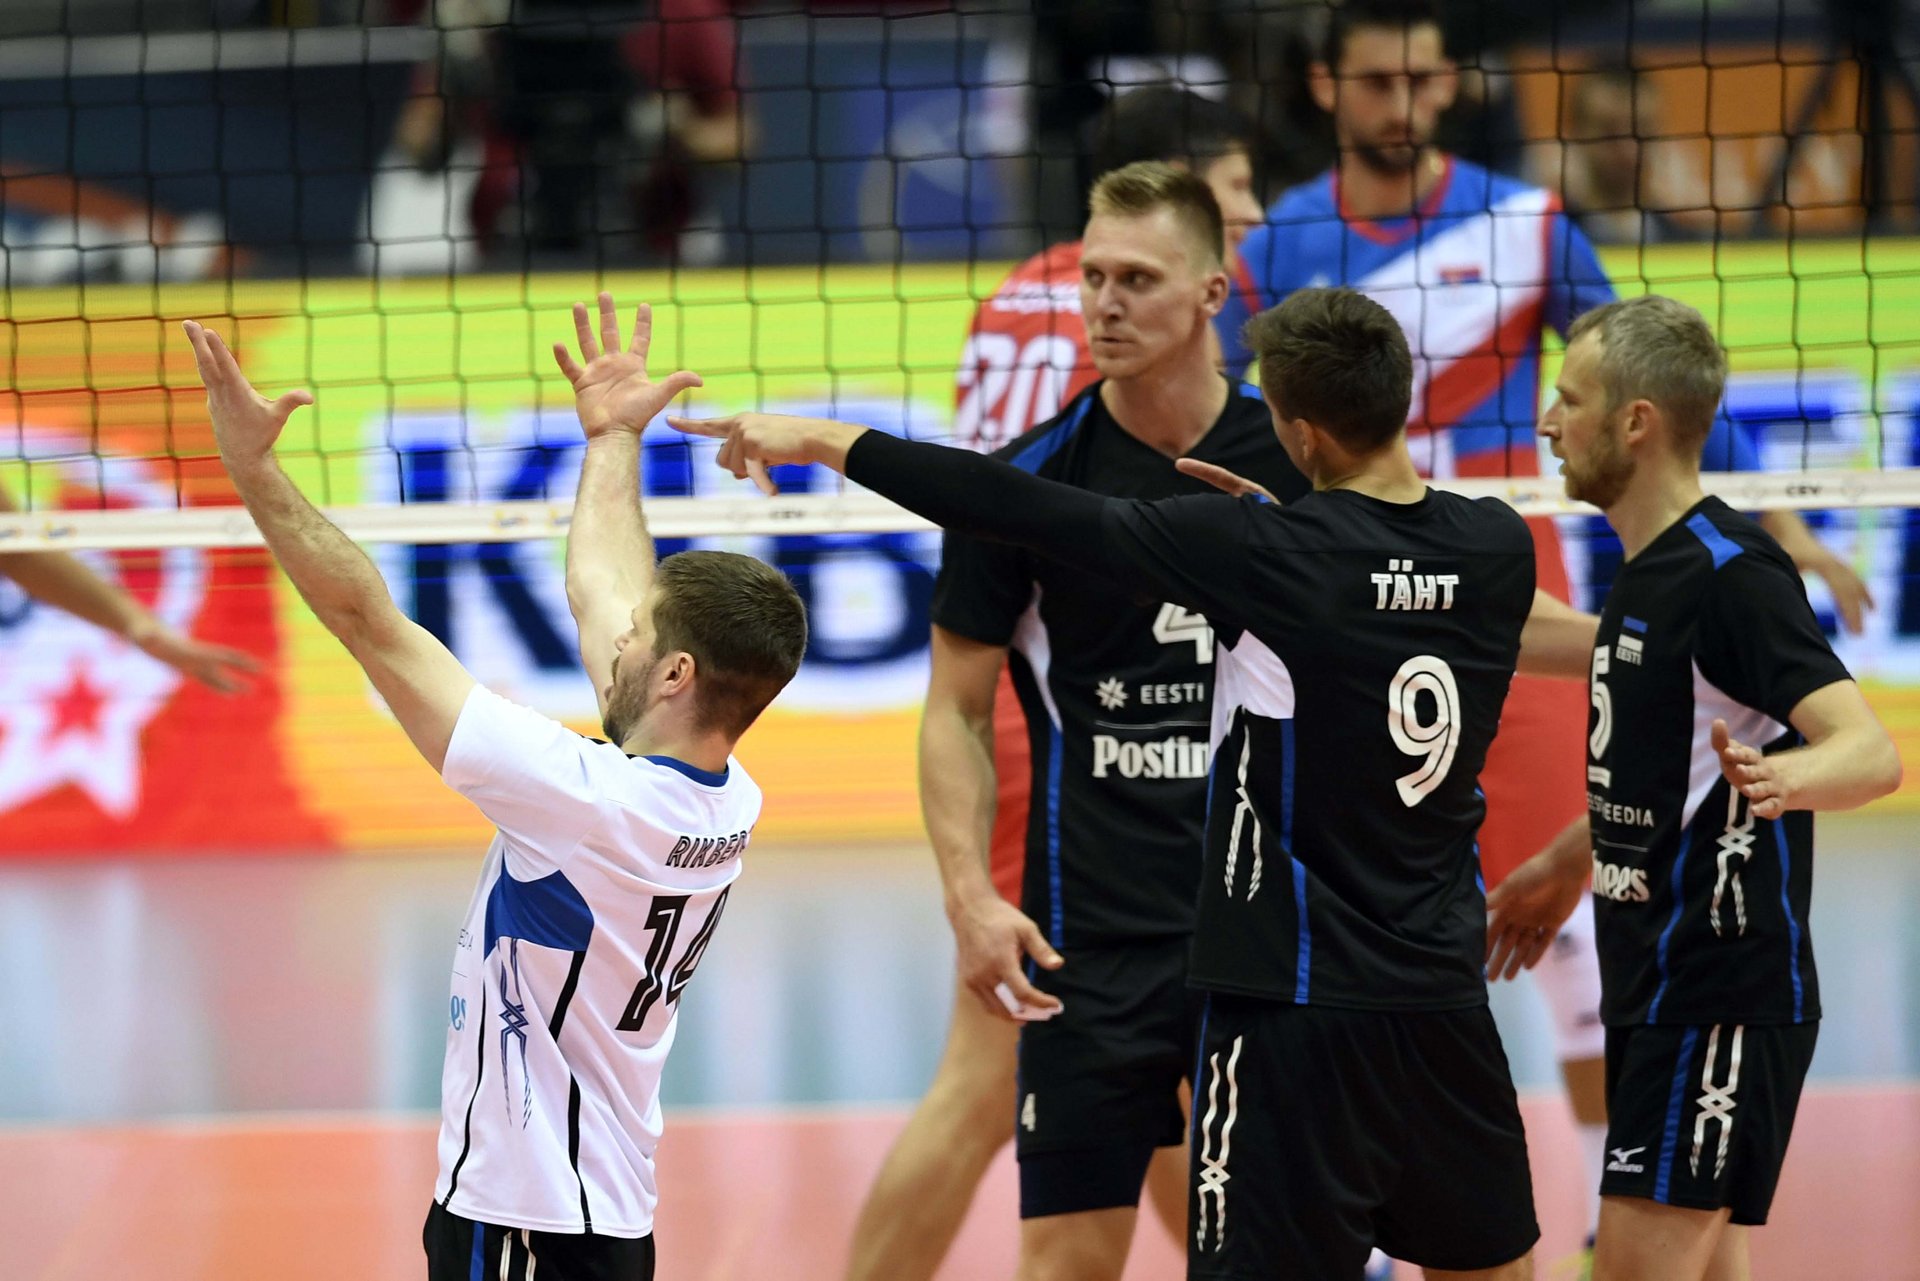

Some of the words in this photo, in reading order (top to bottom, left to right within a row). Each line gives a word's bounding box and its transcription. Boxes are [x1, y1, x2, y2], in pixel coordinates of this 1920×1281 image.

[1371, 558, 1459, 611] TÄHT
[1140, 682, 1204, 705] EESTI
[1388, 654, 1461, 808] 9
[1603, 802, 1655, 827] EEDIA
[665, 824, 755, 869] RIKBER
[615, 882, 733, 1032] 14
[1021, 1093, 1036, 1131] 4
